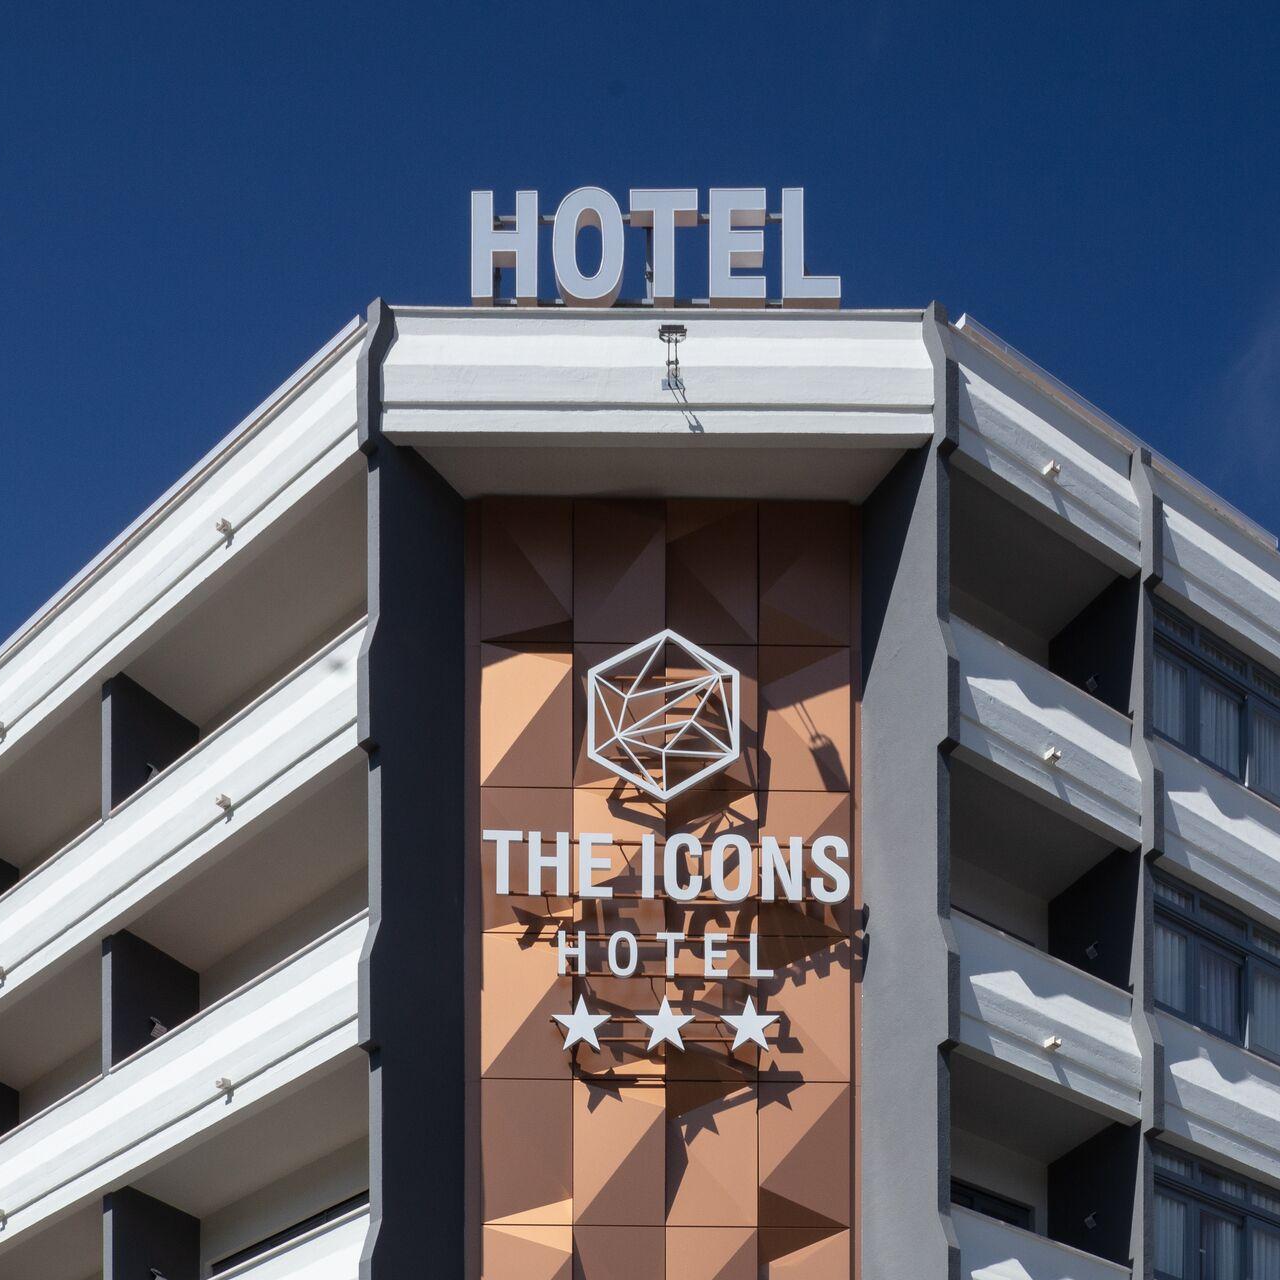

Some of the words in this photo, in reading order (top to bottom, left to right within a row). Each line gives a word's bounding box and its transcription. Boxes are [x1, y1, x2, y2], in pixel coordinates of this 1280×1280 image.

[471, 186, 841, 305] HOTEL
[483, 829, 613, 899] THE
[641, 832, 851, 904] ICONS
[557, 929, 774, 981] HOTEL
